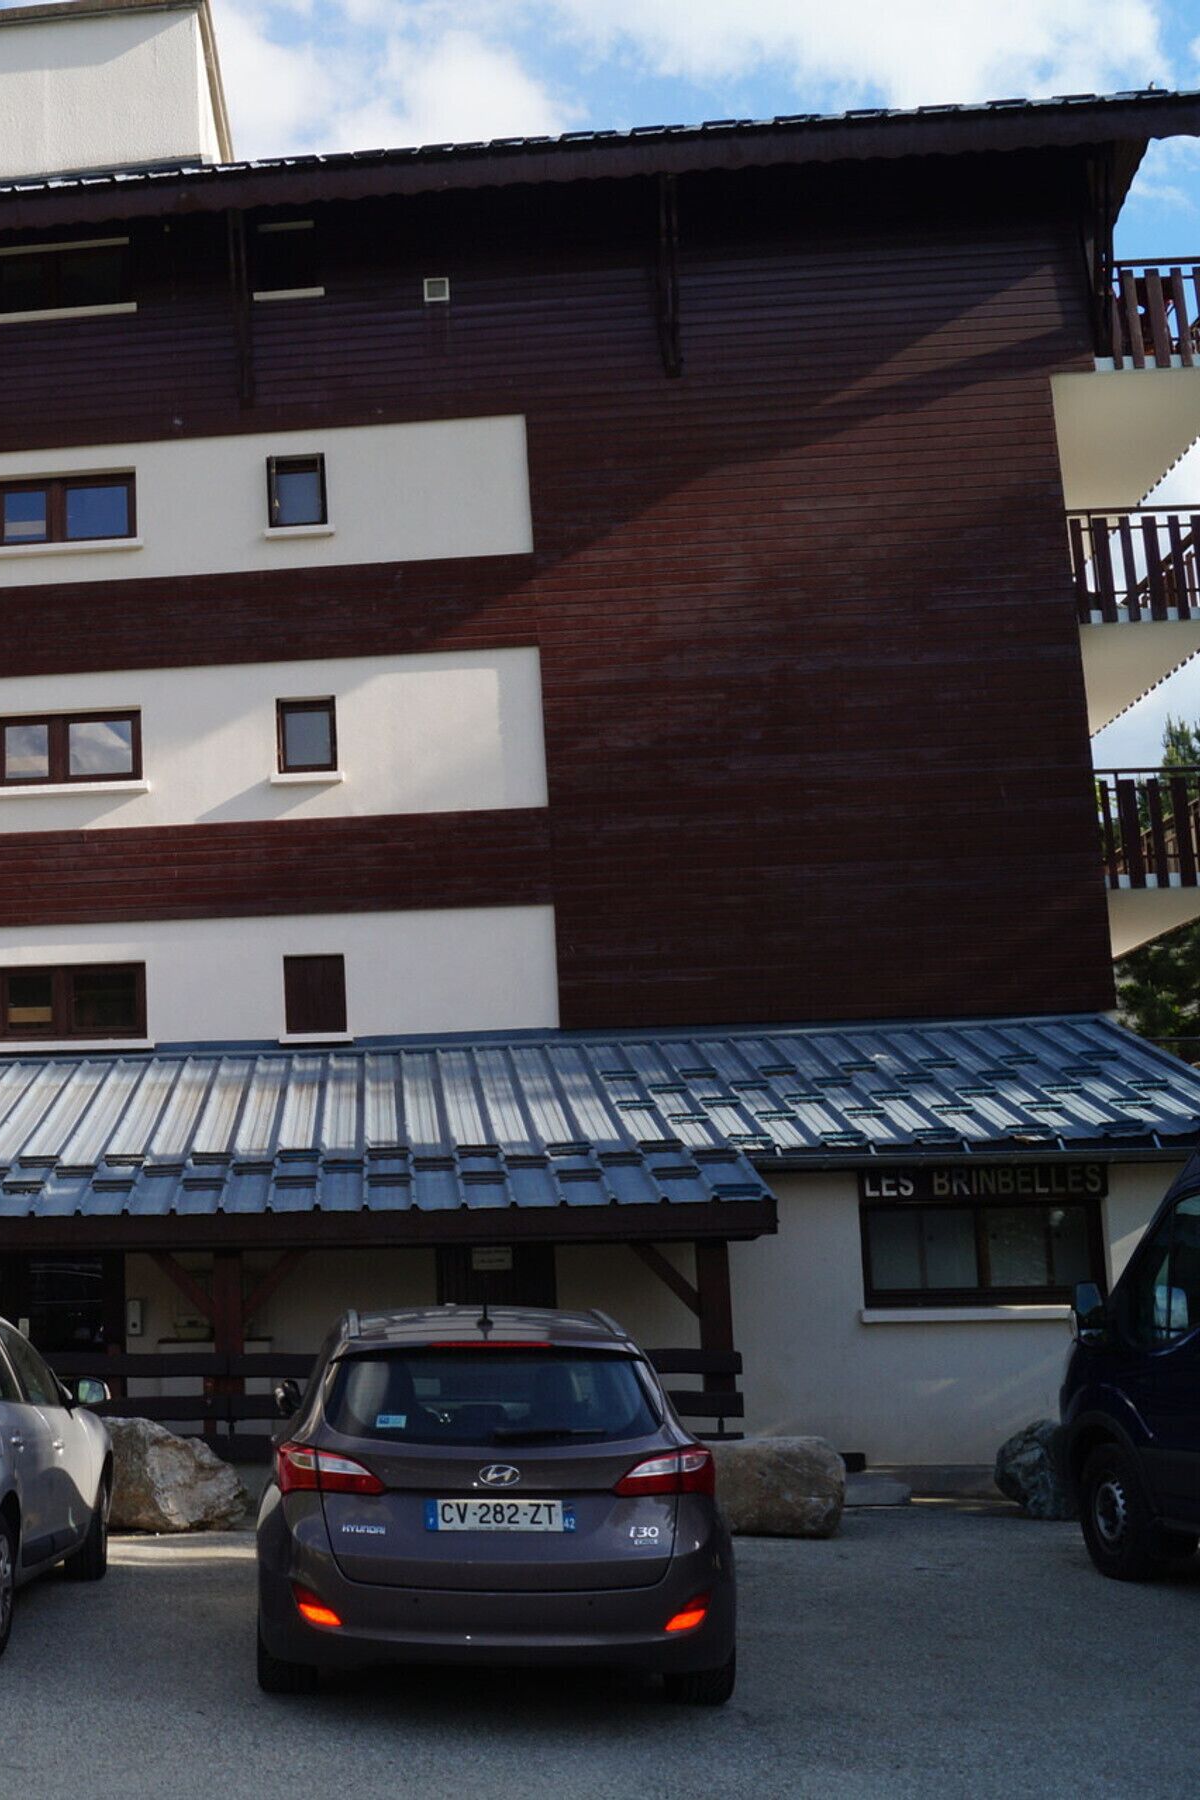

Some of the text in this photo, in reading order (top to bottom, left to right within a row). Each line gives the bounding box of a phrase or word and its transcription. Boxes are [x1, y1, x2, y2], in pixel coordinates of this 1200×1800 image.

[865, 1164, 1101, 1197] LES BRINBELLES
[440, 1503, 556, 1525] CV-282-ZT
[563, 1517, 576, 1529] 42
